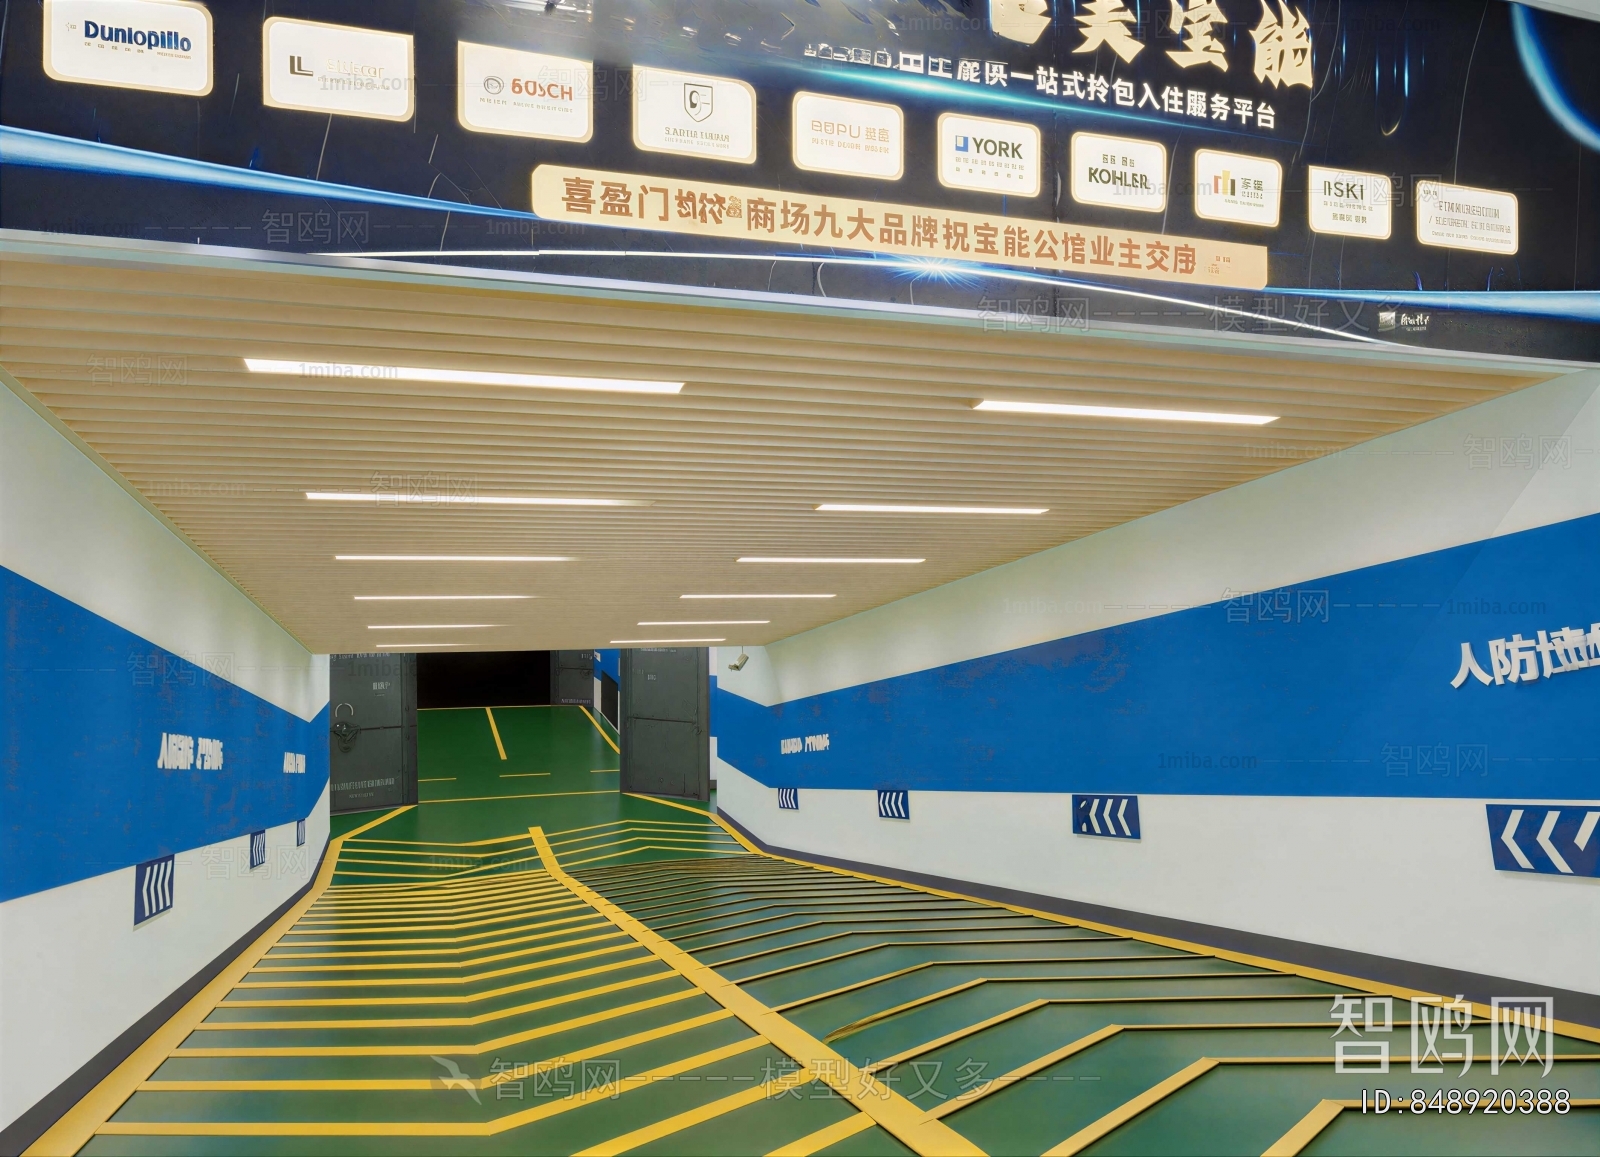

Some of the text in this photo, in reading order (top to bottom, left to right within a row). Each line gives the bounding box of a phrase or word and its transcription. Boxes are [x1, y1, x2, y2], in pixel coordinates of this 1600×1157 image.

[84, 20, 192, 52] Dunlopillo
[972, 136, 1024, 160] YORK
[1088, 166, 1151, 190] KOHLER
